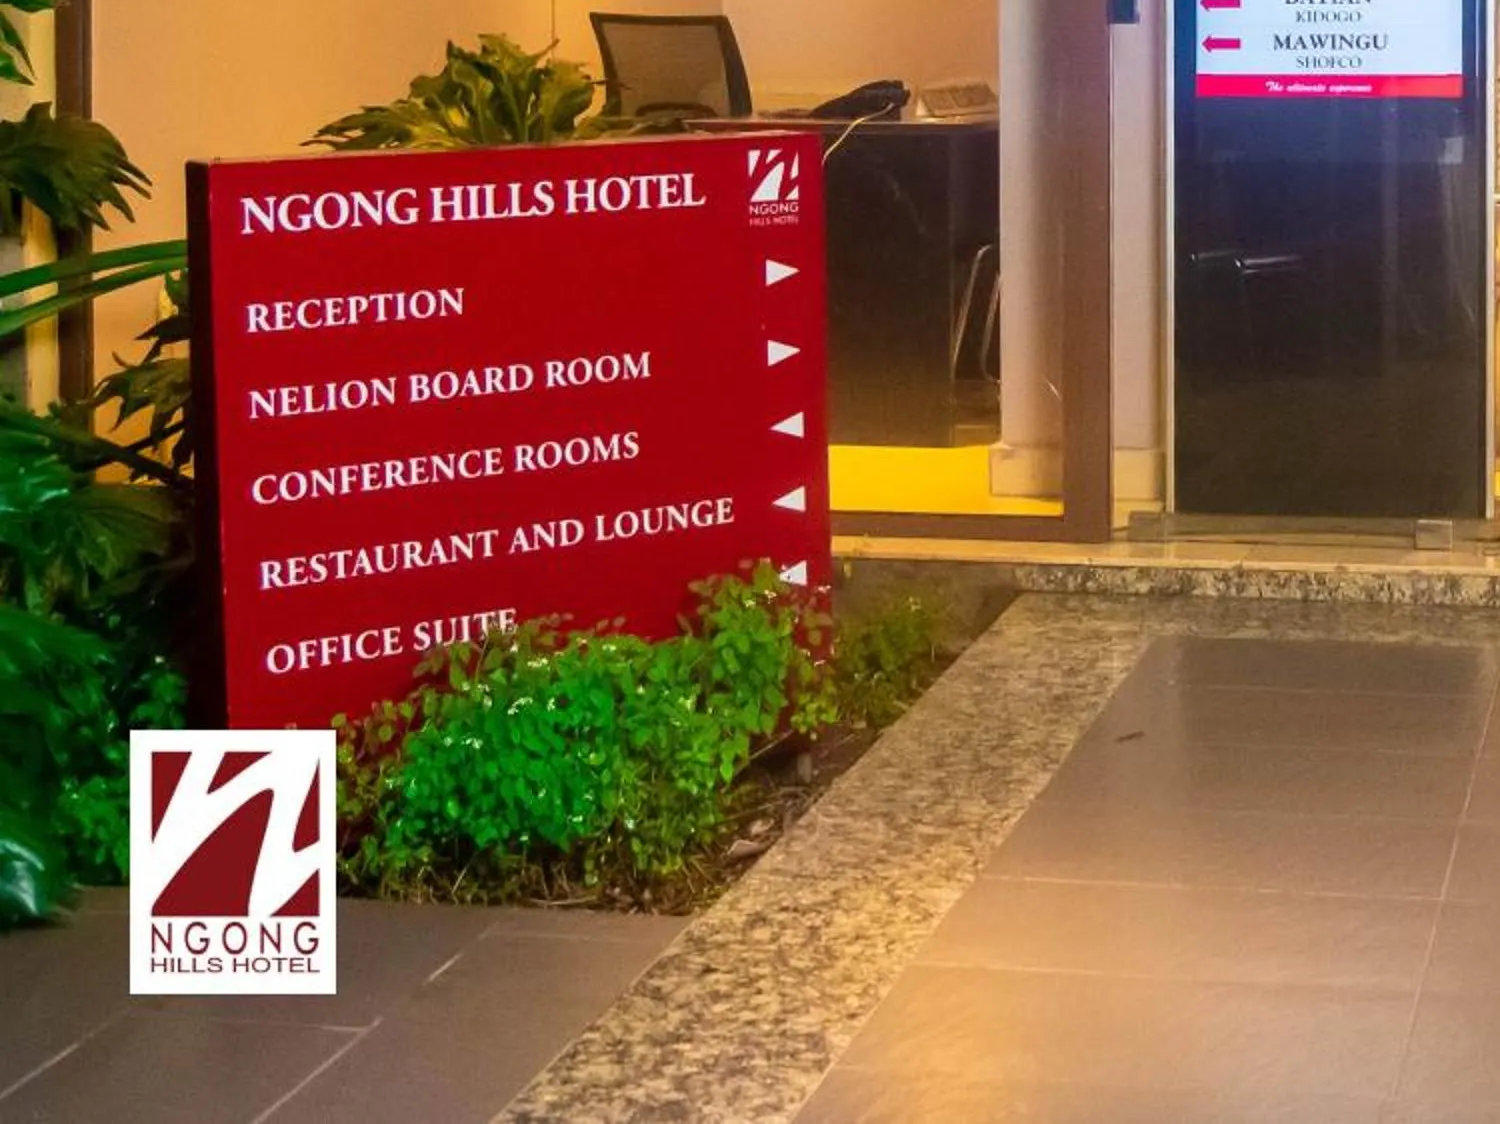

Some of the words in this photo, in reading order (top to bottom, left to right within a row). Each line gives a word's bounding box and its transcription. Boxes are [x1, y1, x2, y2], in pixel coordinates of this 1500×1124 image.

[1273, 33, 1388, 51] MAWINGU
[1295, 10, 1362, 24] KIDOGO
[1295, 55, 1363, 69] SHOFCO
[239, 186, 420, 236] NGONG
[429, 179, 556, 223] HILLS
[564, 172, 707, 215] HOTEL
[748, 201, 799, 215] NGONG
[246, 286, 465, 334] RECEPTION
[248, 375, 398, 420] NELION
[408, 362, 535, 404] BOARD
[544, 350, 652, 389] ROOM
[250, 446, 505, 506] CONFERENCE
[514, 430, 641, 473] ROOMS
[259, 528, 500, 591] RESTAURANT
[508, 518, 586, 555] AND
[594, 496, 735, 542] LOUNGE
[265, 625, 404, 675] OFFICE
[412, 607, 518, 652] SUITE
